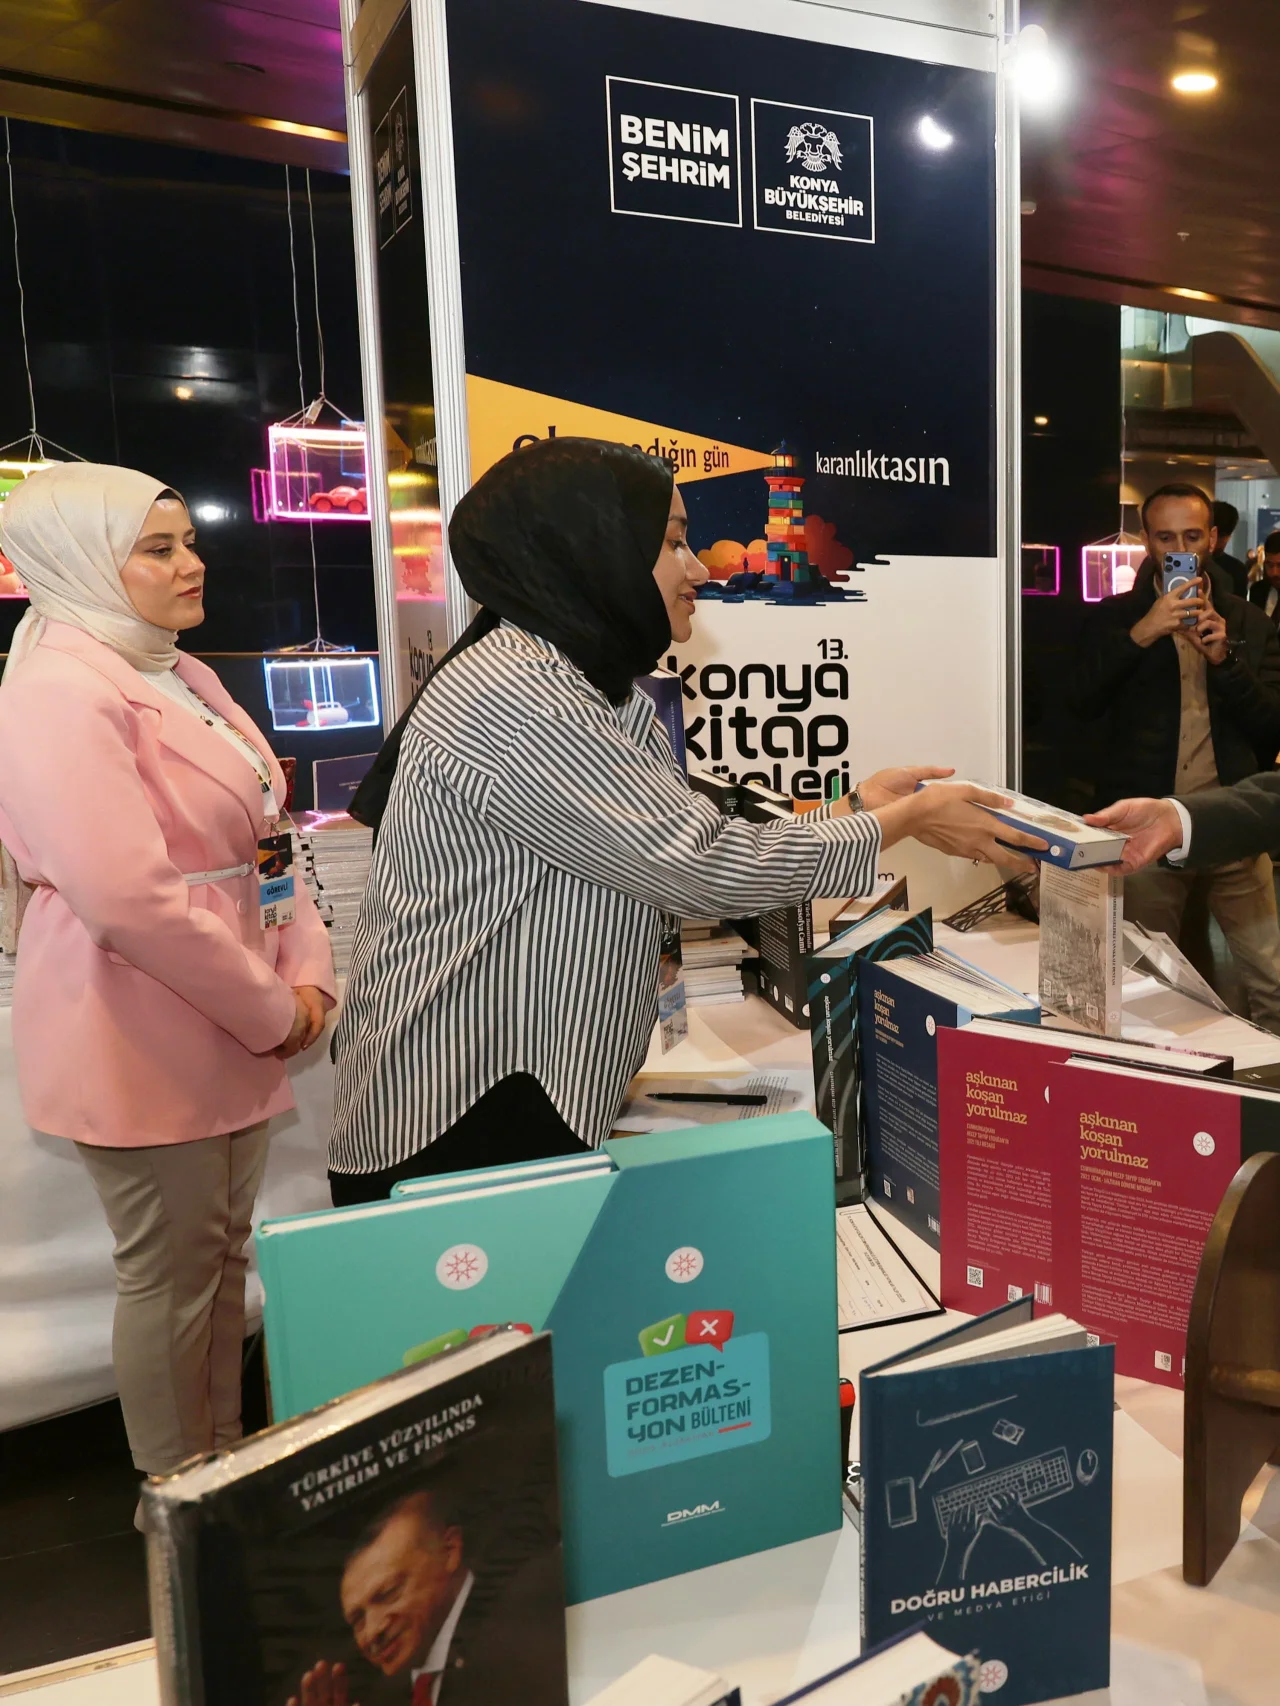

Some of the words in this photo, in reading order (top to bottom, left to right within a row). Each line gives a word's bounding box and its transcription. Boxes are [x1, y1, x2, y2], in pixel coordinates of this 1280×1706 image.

[620, 113, 730, 158] BENİM
[621, 151, 731, 190] ŞEHRİM
[789, 174, 840, 194] KONYA
[764, 186, 864, 217] BÜYÜKŞEHİR
[785, 209, 845, 226] BELEDİYESİ
[703, 439, 729, 473] gün
[815, 448, 950, 487] karanlıktasın
[817, 638, 849, 660] 13.
[667, 655, 849, 712] konya
[266, 881, 289, 896] GÖREVLİ
[795, 903, 805, 932] yasofya
[798, 930, 807, 954] Camii
[873, 989, 895, 1008] aşkınan
[873, 998, 890, 1017] koşan
[874, 1013, 900, 1034] yorulmaz
[966, 1070, 1018, 1091] aşkınan
[966, 1083, 1005, 1105] koşan
[966, 1102, 1028, 1125] yorulmaz
[1079, 1111, 1138, 1133] aşkınan
[1079, 1125, 1123, 1147] koşan
[1080, 1145, 1149, 1169] yorulmaz
[626, 1360, 725, 1397] DEZEN-
[627, 1378, 751, 1421] FORMAS-
[691, 1396, 751, 1430] BÜLTENİ
[289, 1445, 374, 1497] TÜRKİYE
[378, 1394, 483, 1453] YÜZYILINDA
[300, 1461, 380, 1512] YATIRIM
[385, 1449, 410, 1469] VE
[413, 1414, 477, 1456] FİNANS
[667, 1500, 720, 1523] DMM
[890, 1586, 966, 1615] DOĞRU
[970, 1562, 1089, 1600] HABERCİLİK
[927, 1611, 945, 1622] VE
[954, 1601, 1003, 1616] MEDYA
[1012, 1591, 1051, 1607] ETİĞİ
